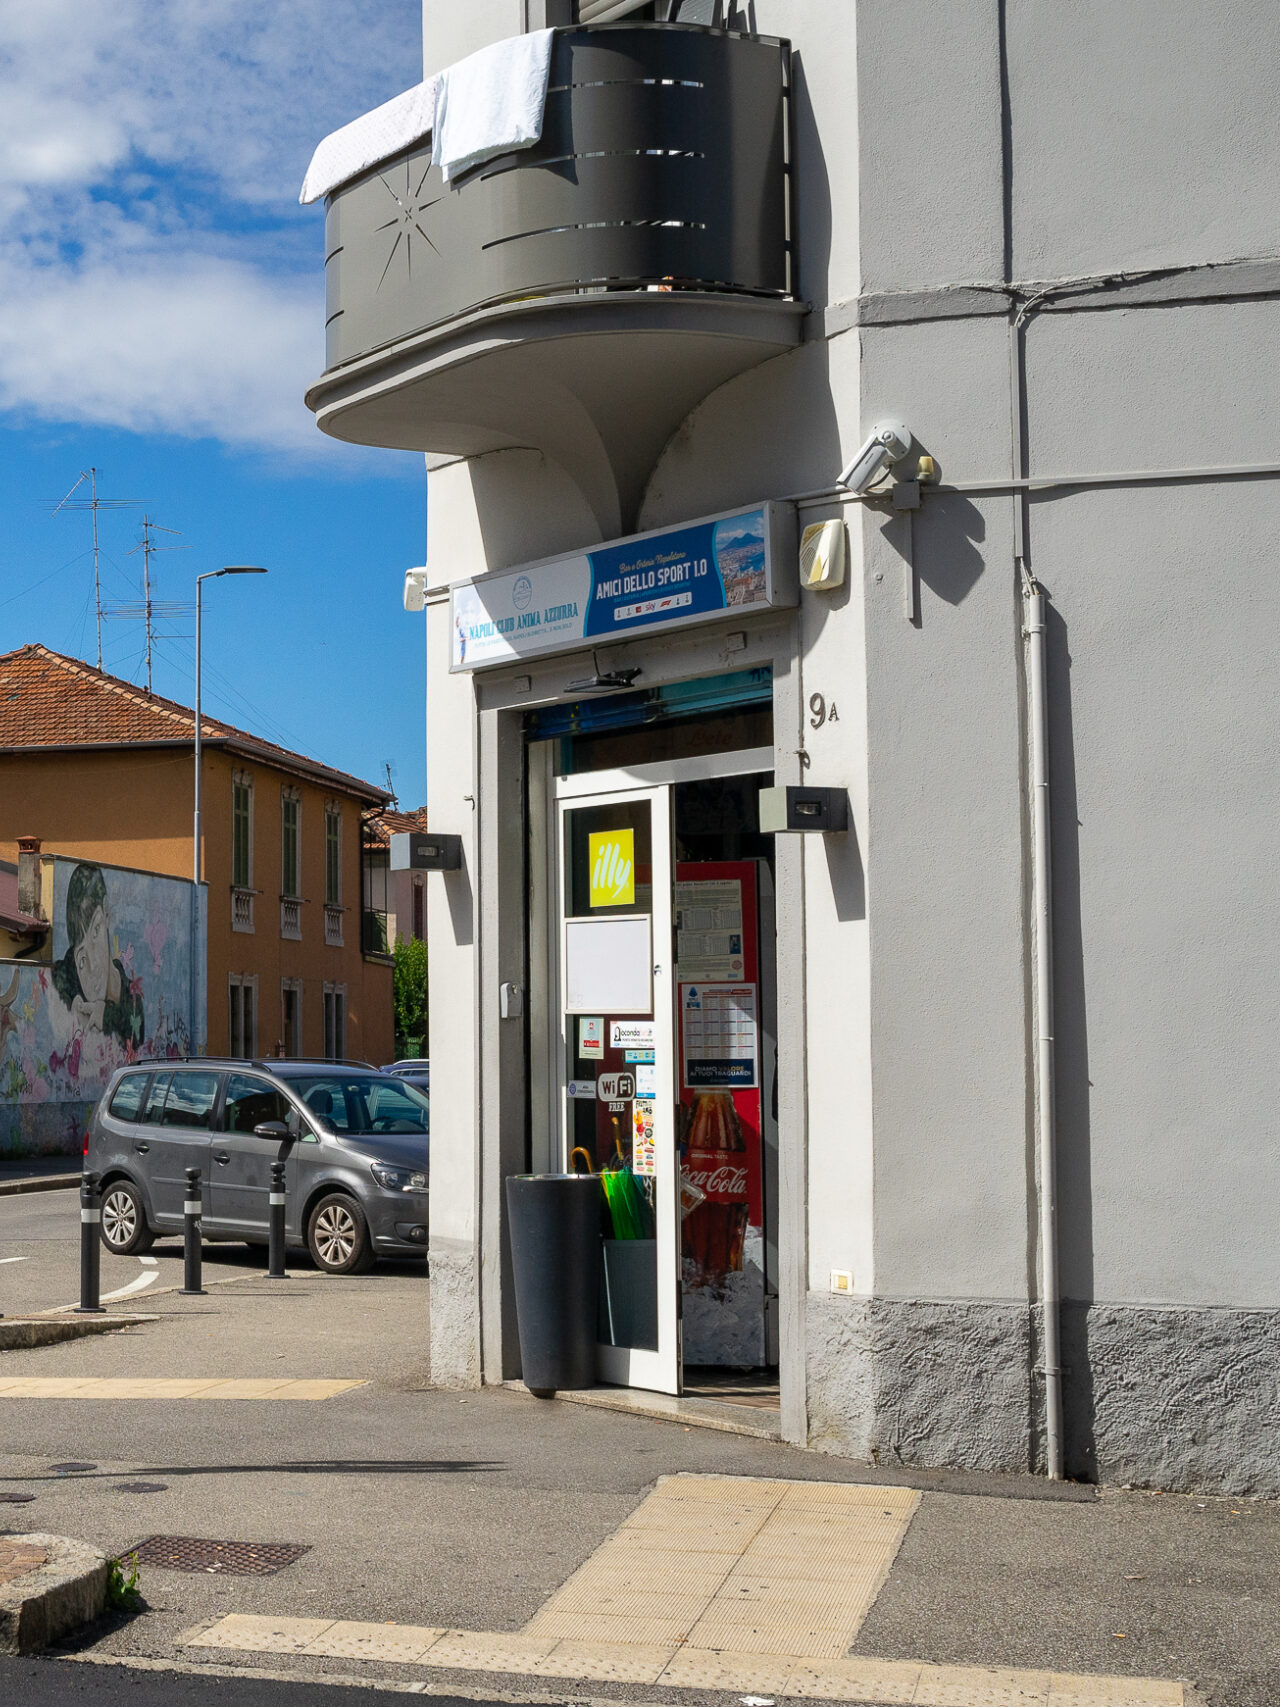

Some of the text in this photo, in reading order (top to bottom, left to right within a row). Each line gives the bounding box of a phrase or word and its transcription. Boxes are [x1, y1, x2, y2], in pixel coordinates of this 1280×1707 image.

[596, 579, 621, 600] AMICI
[624, 571, 655, 594] DELLO
[657, 562, 691, 586] SPORT
[469, 621, 496, 641] NAPOLI
[496, 617, 515, 634] CLUB
[517, 610, 542, 630] ANIMA
[543, 602, 579, 624] AZZURRA
[593, 843, 631, 898] illy
[608, 1102, 625, 1112] FREE
